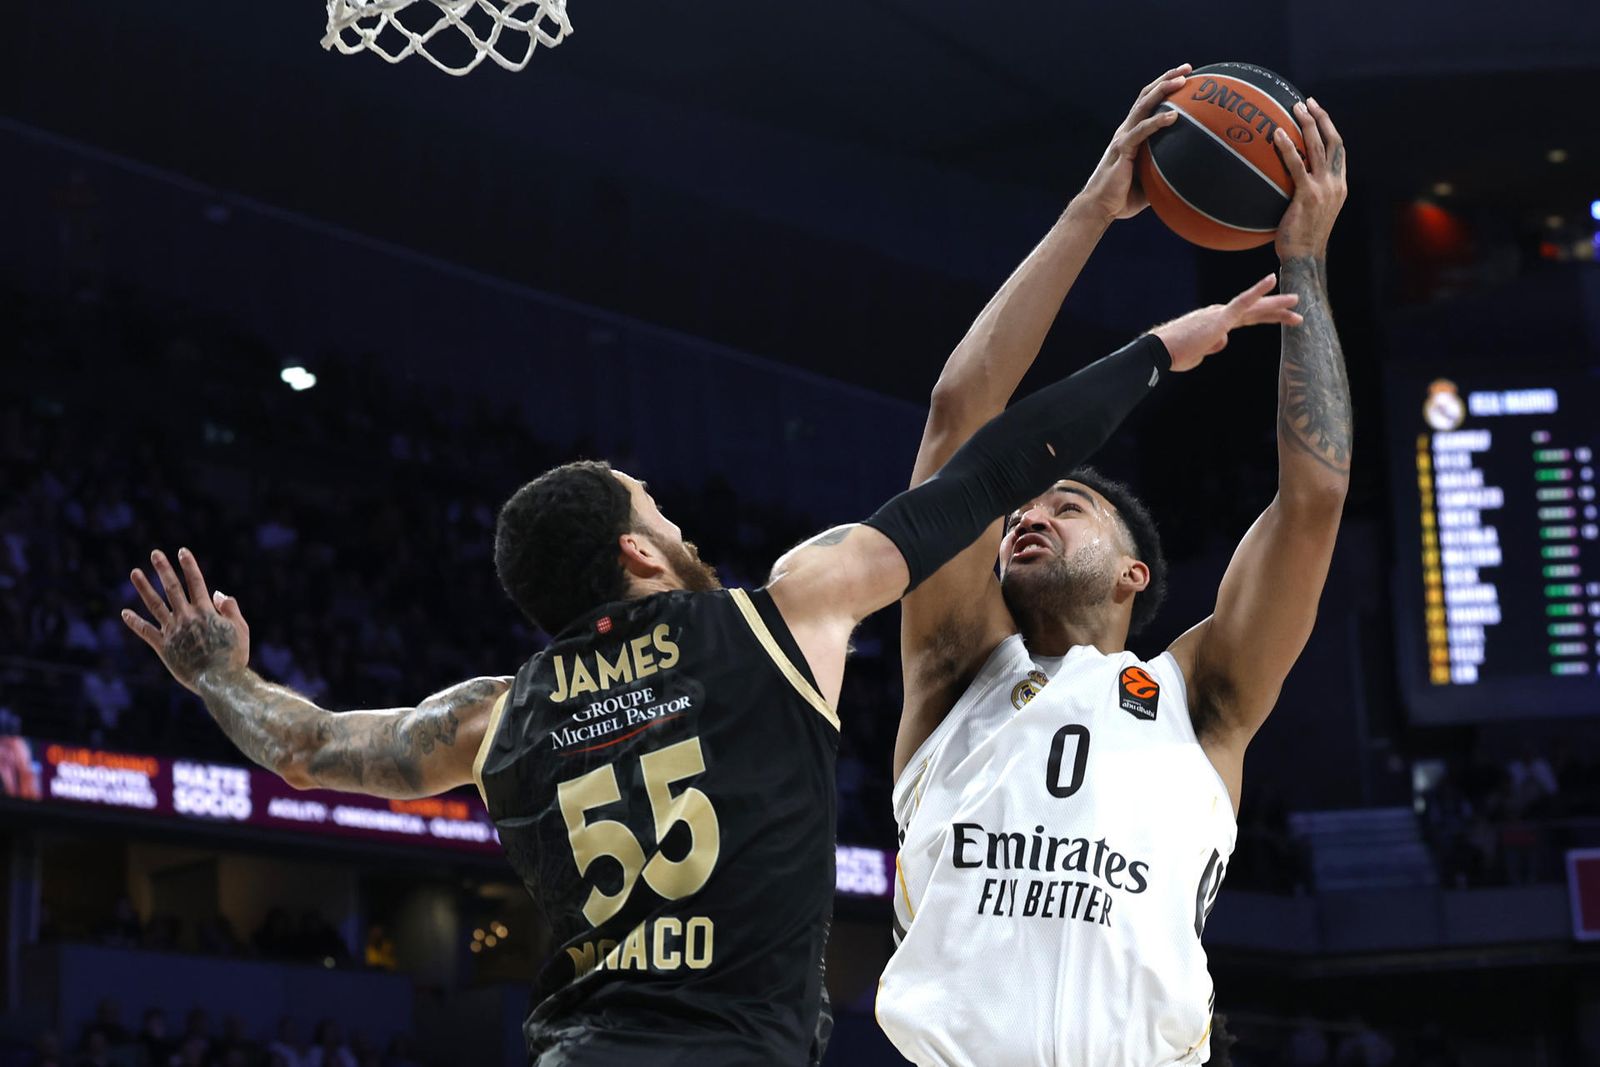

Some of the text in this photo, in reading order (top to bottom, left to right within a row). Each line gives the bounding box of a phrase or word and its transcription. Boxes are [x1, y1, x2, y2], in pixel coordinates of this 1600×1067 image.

[1192, 79, 1278, 145] ALDING
[549, 623, 680, 703] JAMES
[550, 695, 693, 750] MICHEL PASTOR
[572, 687, 656, 722] GROUPE
[1046, 723, 1091, 799] 0
[557, 736, 720, 928] 55
[952, 823, 1150, 894] Emirates
[977, 878, 1113, 928] FLY BETTER
